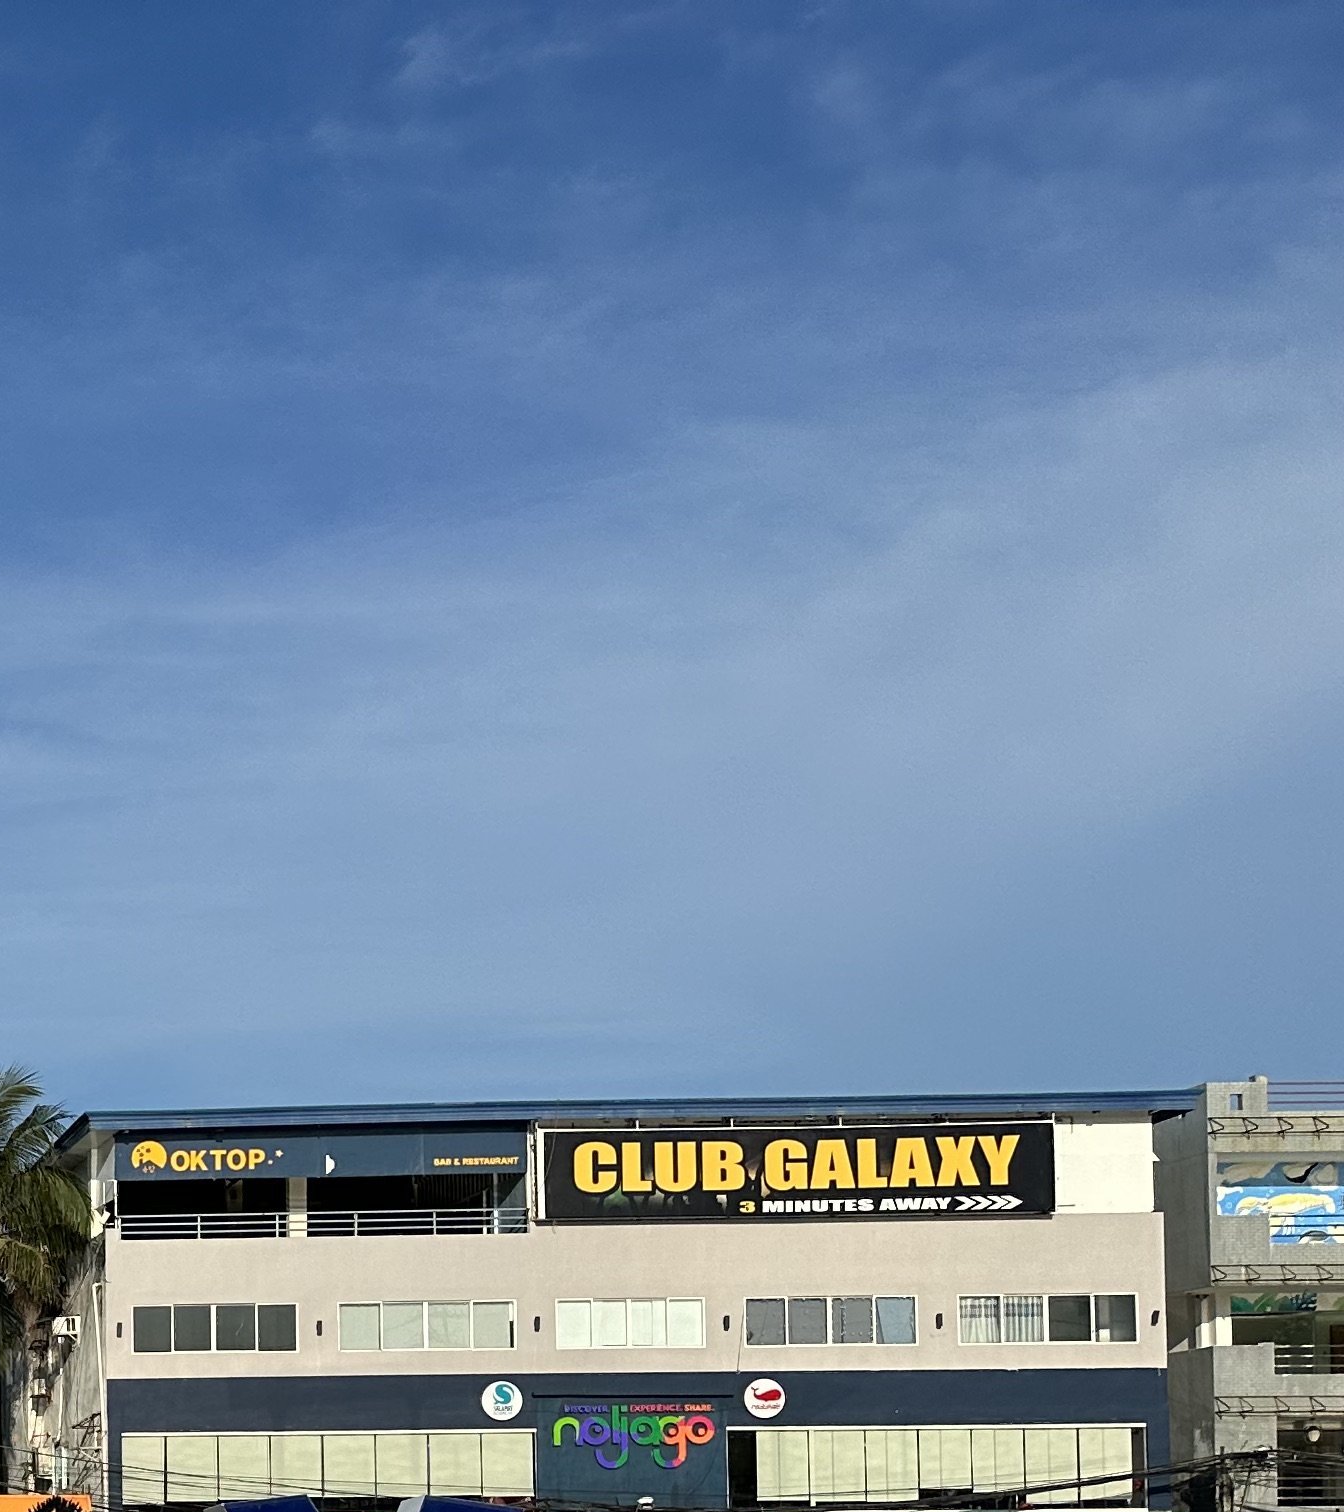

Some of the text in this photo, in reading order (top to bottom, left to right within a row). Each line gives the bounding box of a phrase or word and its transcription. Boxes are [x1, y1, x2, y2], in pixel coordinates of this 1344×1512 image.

[462, 1156, 520, 1166] RESTAURANT
[573, 1134, 1021, 1194] CLUB GALAXY
[739, 1195, 952, 1214] 3 MINUTES AWAY
[553, 1404, 716, 1470] noljago
